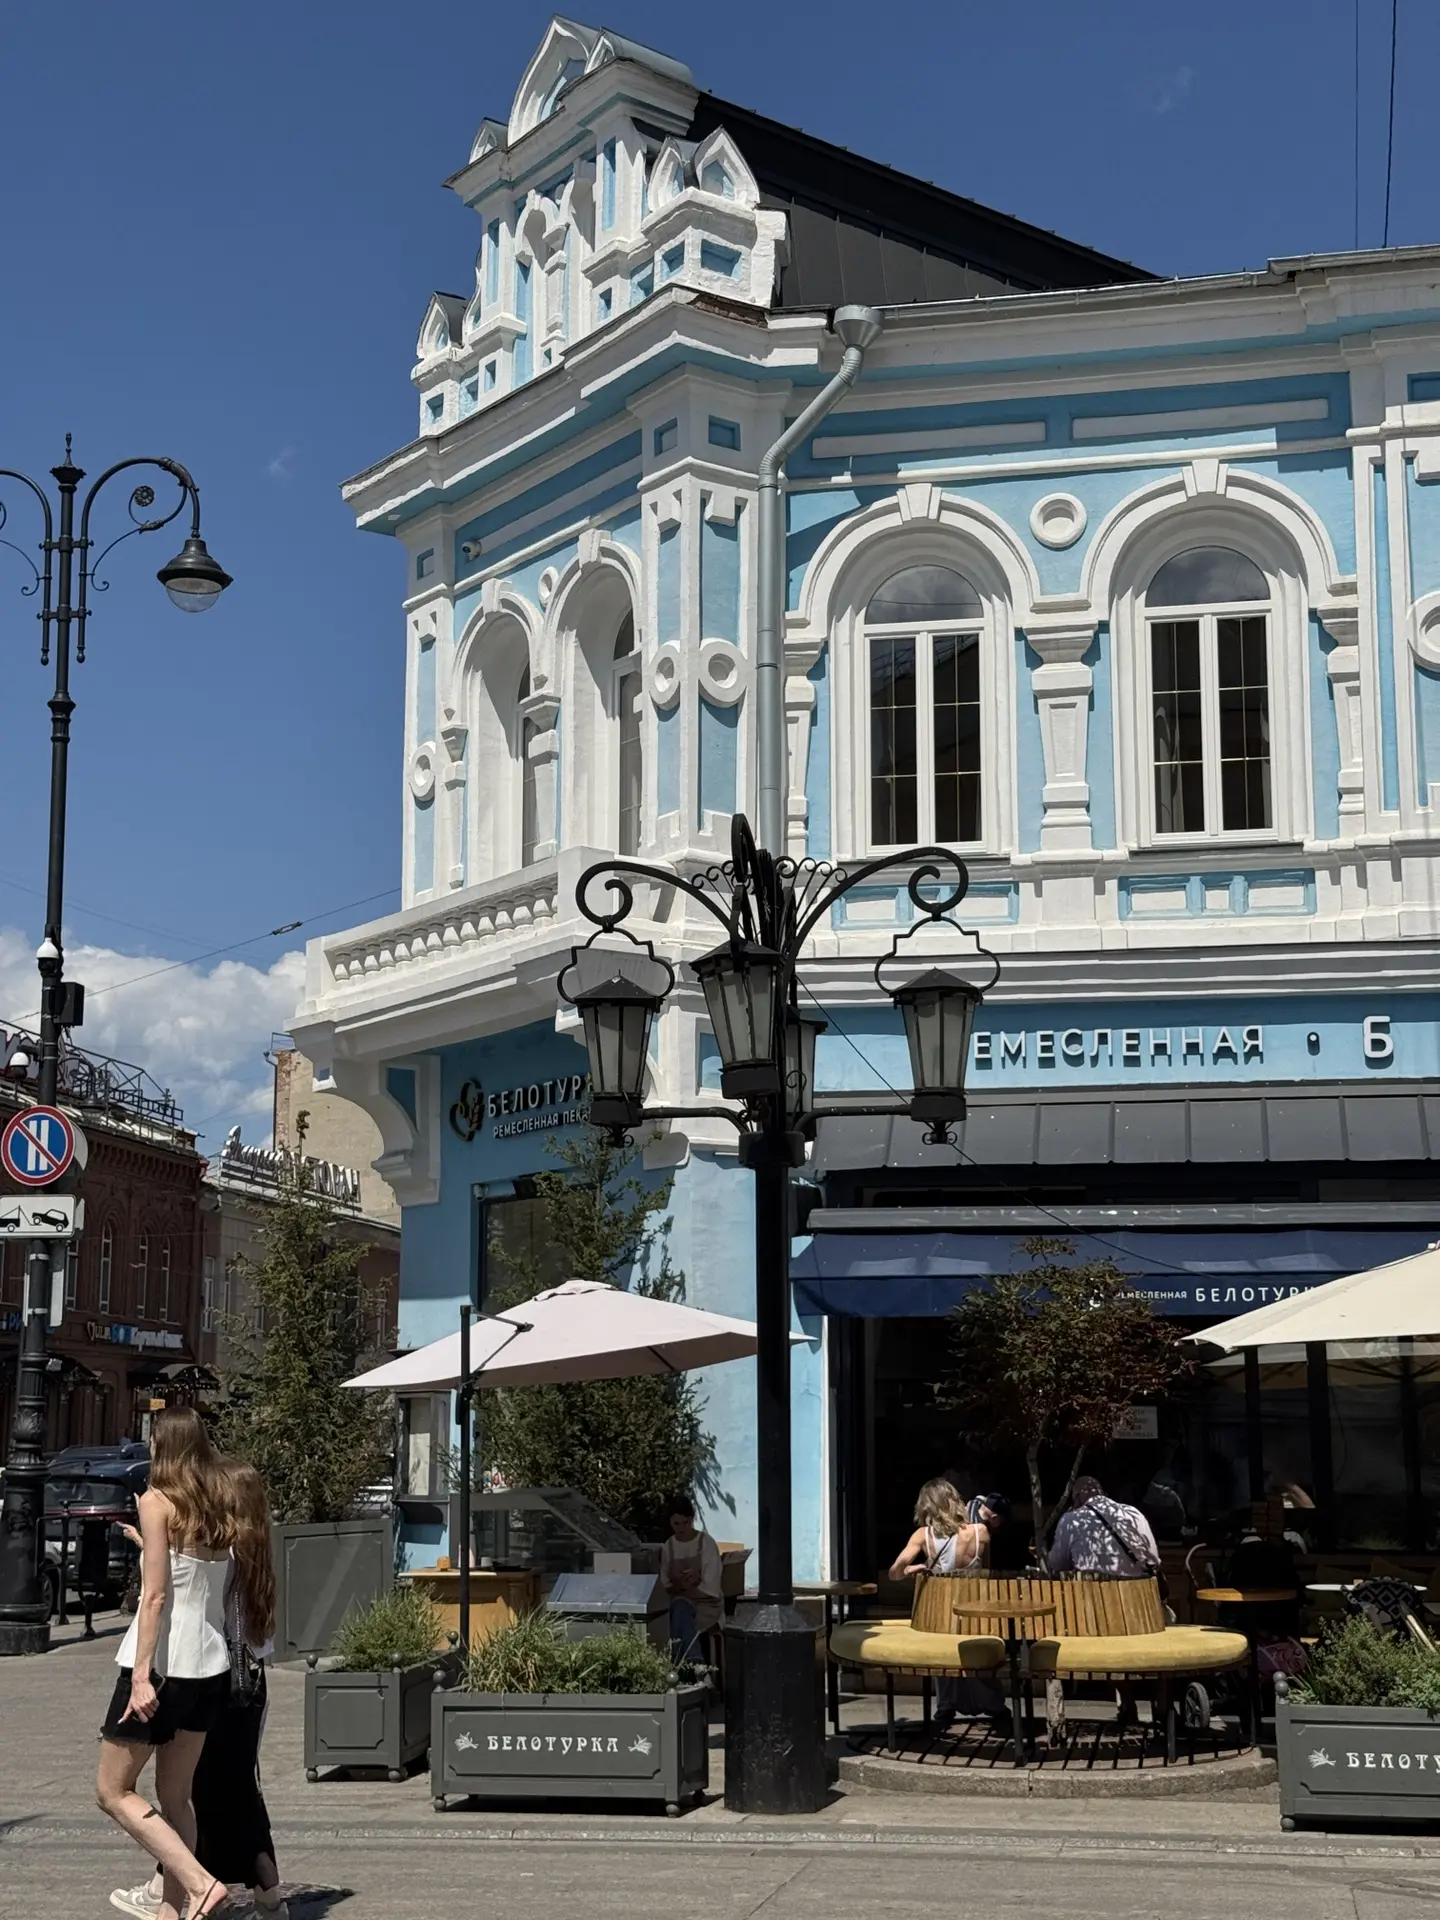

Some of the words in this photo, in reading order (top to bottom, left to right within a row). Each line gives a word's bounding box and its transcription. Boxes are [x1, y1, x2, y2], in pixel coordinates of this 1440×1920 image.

[972, 1024, 1264, 1059] ЕМЕСЛЕННАЯ
[1362, 1015, 1394, 1059] Б
[493, 1112, 559, 1138] РЕМЕСЛЕННАЯ
[1115, 1290, 1188, 1299] ЕМЕСЛЕННАЯ
[1195, 1286, 1314, 1303] БЕЛОТУР
[487, 1735, 619, 1755] БЕЛОТУРКА
